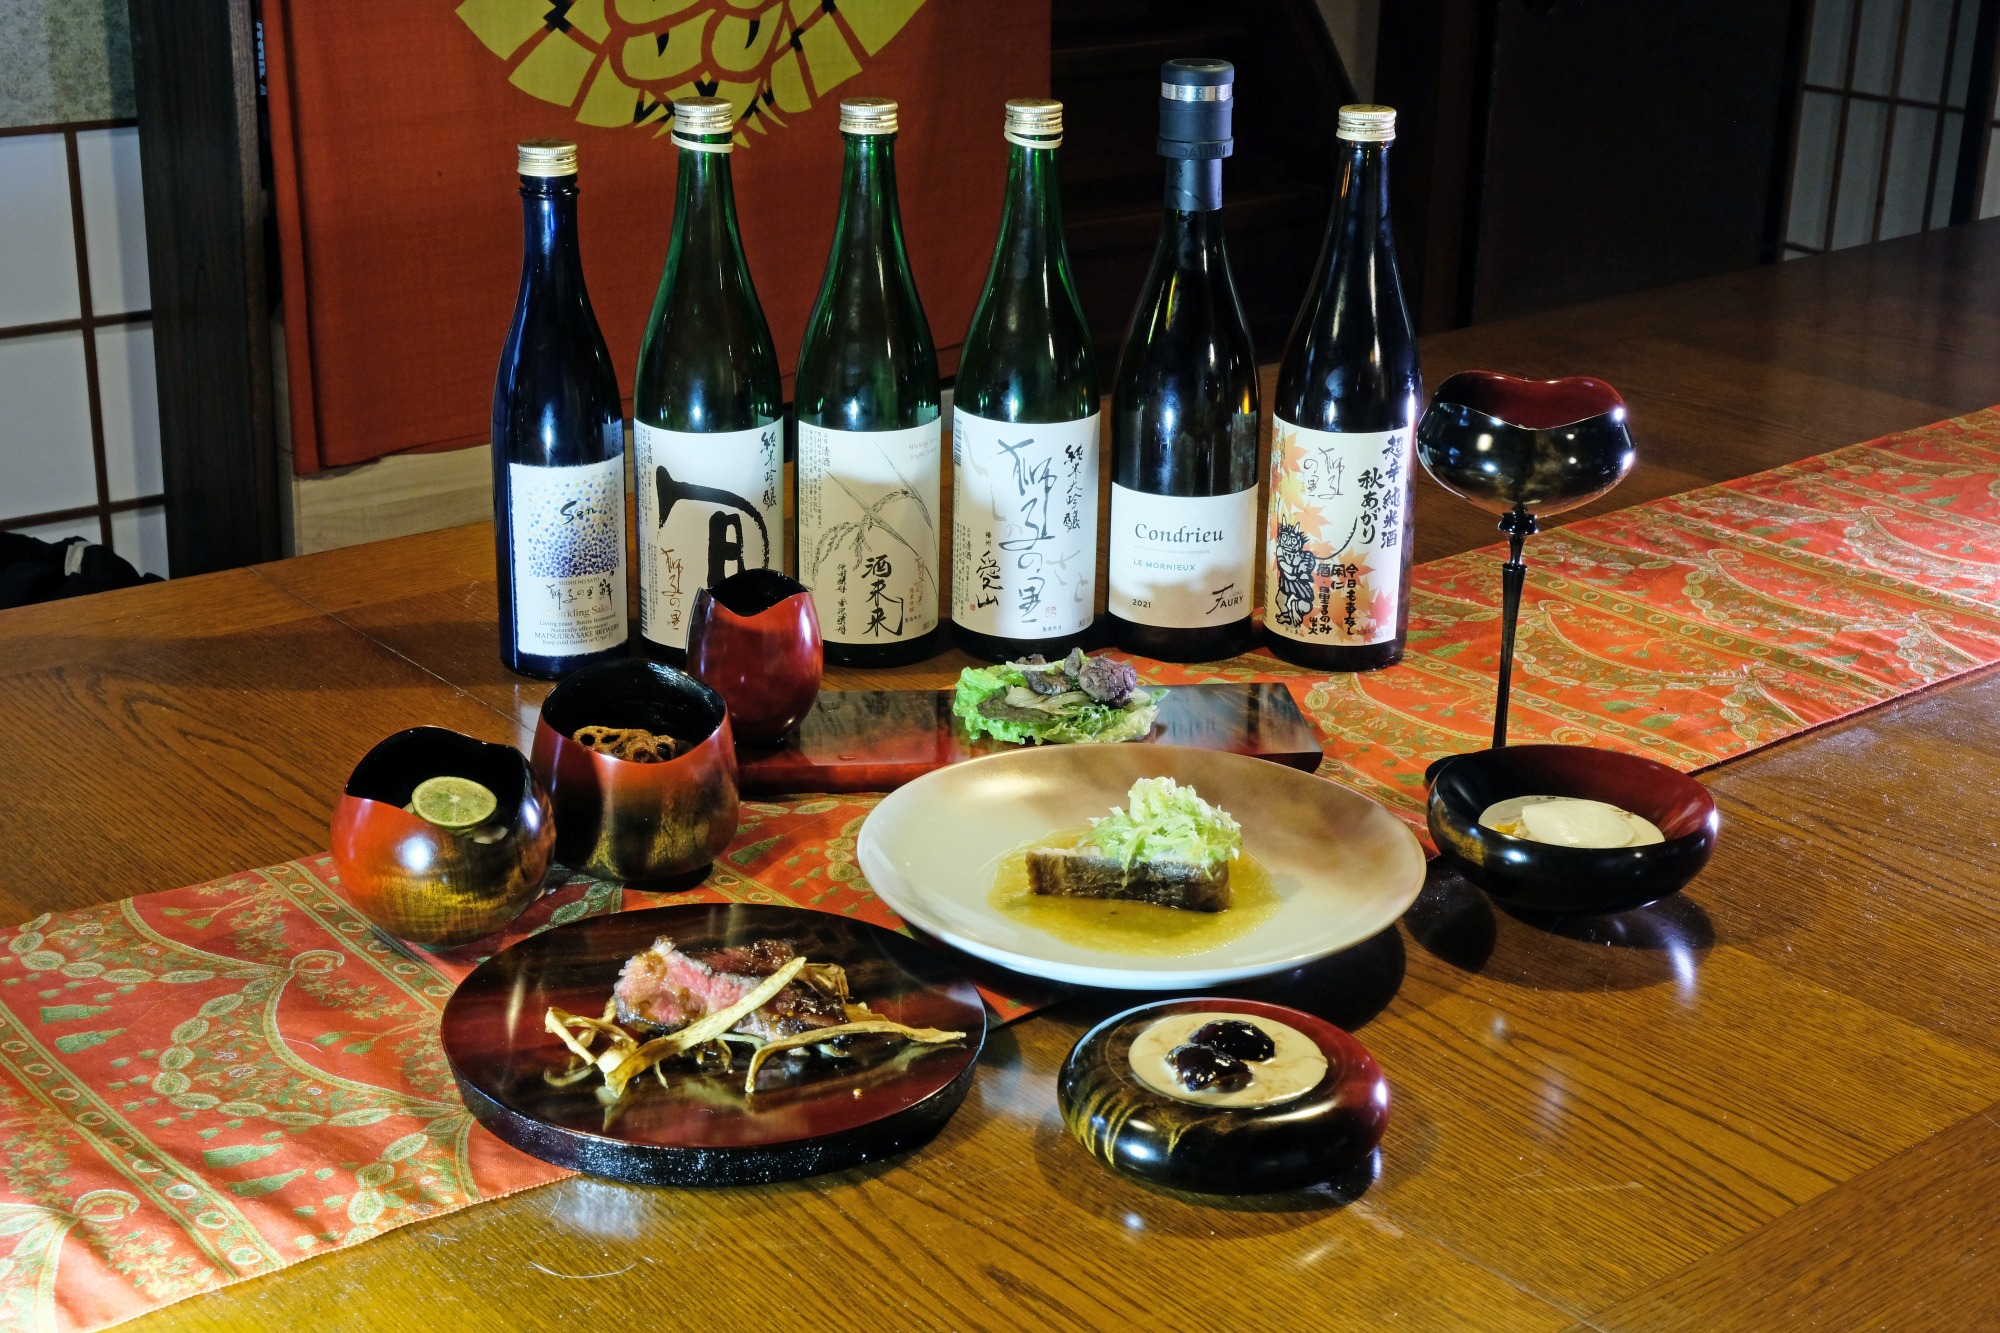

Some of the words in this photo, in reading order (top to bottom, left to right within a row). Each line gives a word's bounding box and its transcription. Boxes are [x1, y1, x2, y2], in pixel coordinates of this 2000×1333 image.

[760, 429, 777, 512] 純米吟醸
[1062, 443, 1083, 533] 純米大吟醸
[1357, 467, 1385, 545] 秋あがり
[995, 438, 1058, 624] 獅子の里
[1134, 523, 1225, 543] Condrieu
[975, 549, 1004, 609] 愛山
[1133, 558, 1143, 567] LE
[1145, 561, 1196, 571] MORNIEUX
[660, 547, 684, 631] 獅子の里
[1132, 599, 1151, 609] 2021
[1205, 582, 1244, 615] FAURY
[534, 631, 574, 640] MATSUURA
[576, 630, 594, 639] SAKE
[594, 623, 620, 636] BREWERY
[576, 618, 592, 626] Bottle
